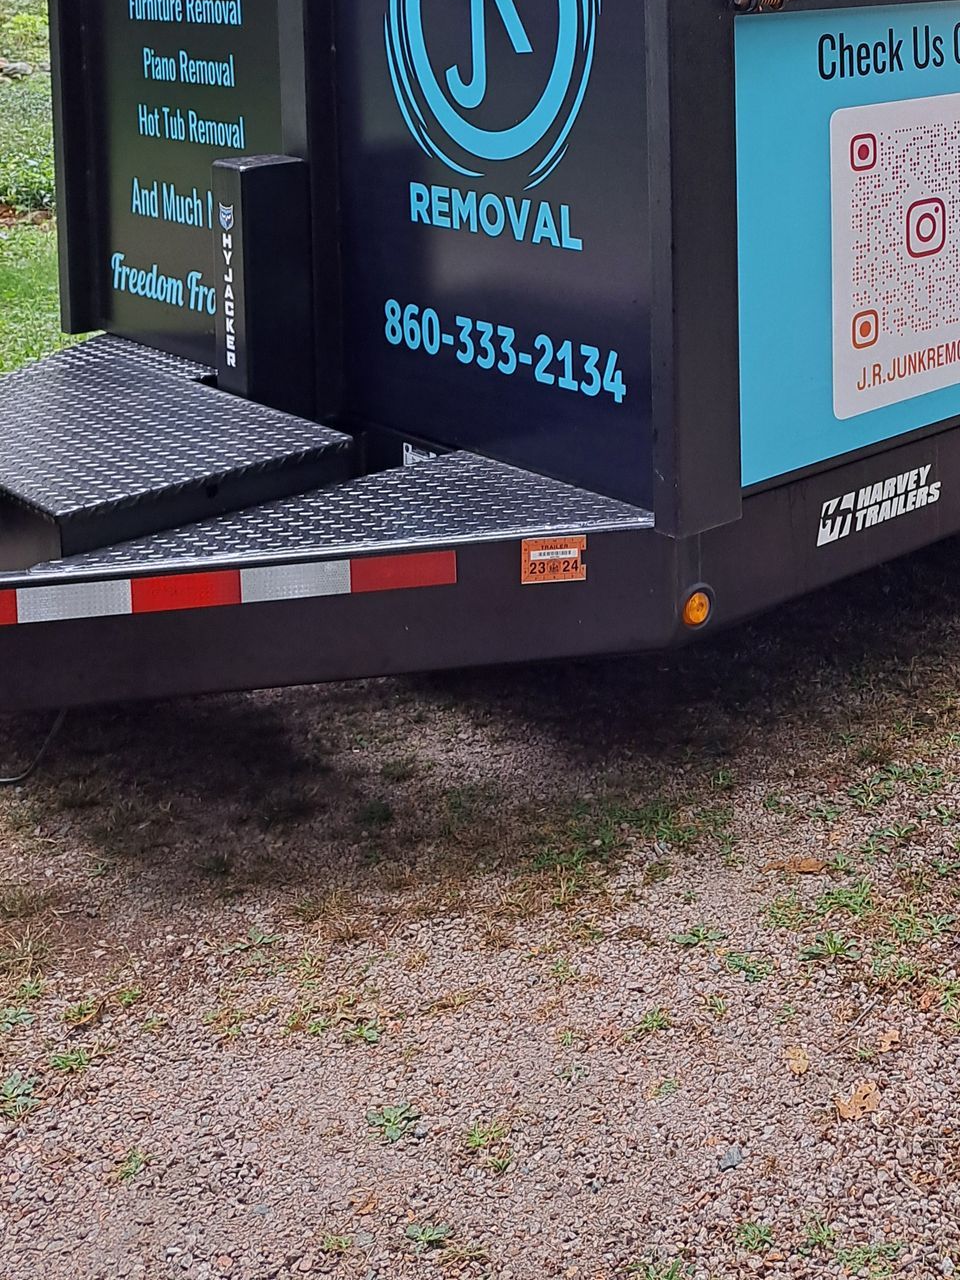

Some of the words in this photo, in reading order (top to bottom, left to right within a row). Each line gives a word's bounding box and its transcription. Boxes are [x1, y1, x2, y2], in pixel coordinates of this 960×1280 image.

[143, 47, 176, 83] Piano
[180, 51, 234, 87] Removal
[818, 28, 903, 80] Check
[913, 25, 944, 69] Us
[138, 104, 160, 137] Hot
[162, 107, 185, 141] Tub
[189, 113, 245, 149] Removal
[132, 176, 158, 218] And
[162, 182, 204, 227] Much
[409, 182, 583, 251] REMOVAL
[111, 253, 184, 307] Freedom
[187, 271, 217, 315] Fro
[221, 233, 236, 367] HYJACKER
[384, 299, 627, 403] 860-333-2134
[855, 481, 942, 531] TRAILERS
[857, 464, 931, 510] HARVEY
[529, 562, 546, 575] 23
[562, 560, 578, 572] 24
